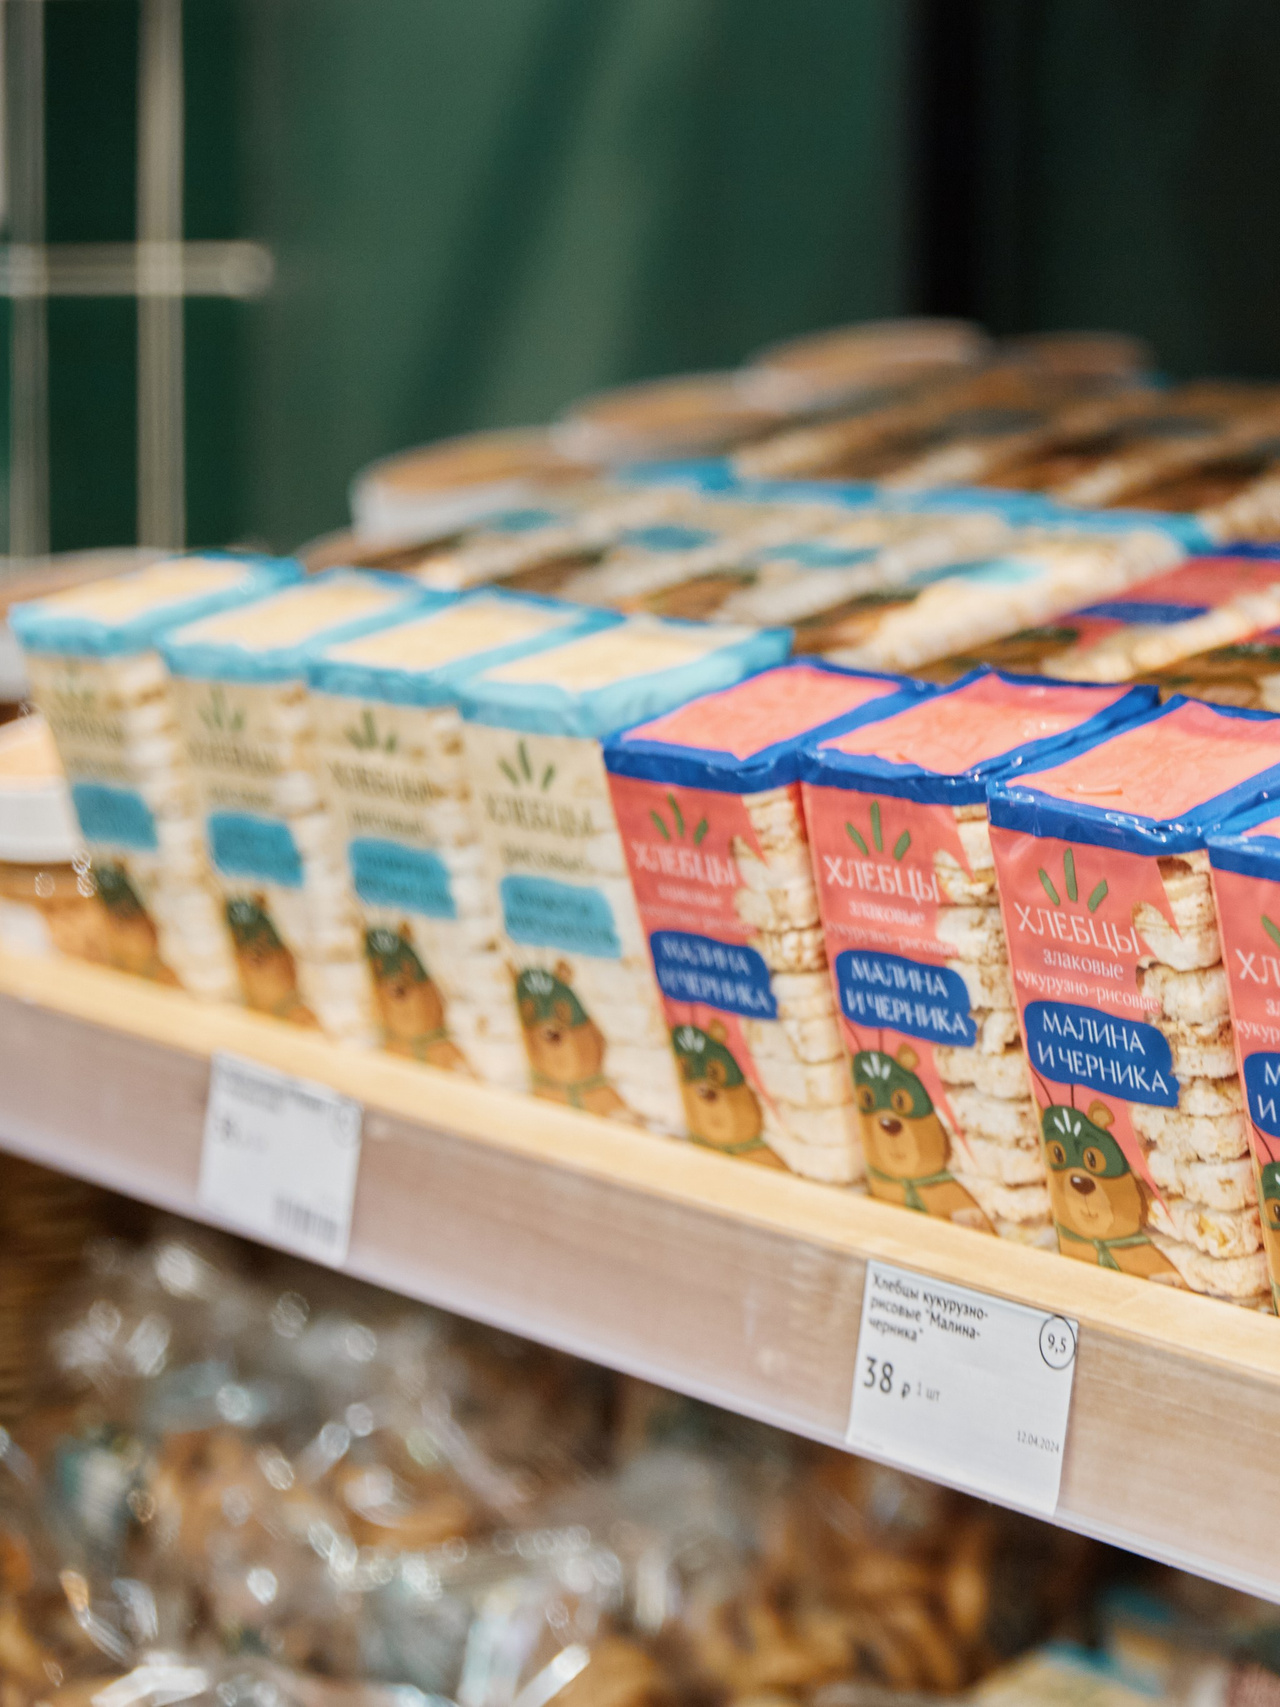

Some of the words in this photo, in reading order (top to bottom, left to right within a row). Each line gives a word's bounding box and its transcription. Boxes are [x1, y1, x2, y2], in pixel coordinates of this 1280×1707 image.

[823, 854, 941, 906] ХЛЕБЦЫ
[1014, 902, 1141, 957] ХЛЕБЦЫ
[851, 957, 949, 999] МАЛИНА
[1043, 949, 1124, 980] злаковые
[845, 988, 865, 1013] И
[866, 993, 968, 1037] ЧЕРНИКА
[1016, 969, 1160, 1013] кукурузно-рисовые
[1042, 1009, 1146, 1055] МАЛИНА
[1037, 1041, 1055, 1068] И
[1058, 1048, 1169, 1095] ЧЕРНИКА
[1257, 1095, 1279, 1124] И
[870, 1297, 921, 1322] рисовые
[926, 1309, 980, 1339] "Малина-
[872, 1273, 919, 1299] Хлебцы
[922, 1291, 988, 1320] кукурузно-
[868, 1316, 925, 1343] черника"
[1048, 1333, 1067, 1354] 9,5
[863, 1356, 894, 1394] 38
[926, 1387, 940, 1402] шт
[1016, 1430, 1060, 1454] 12.04.2024
